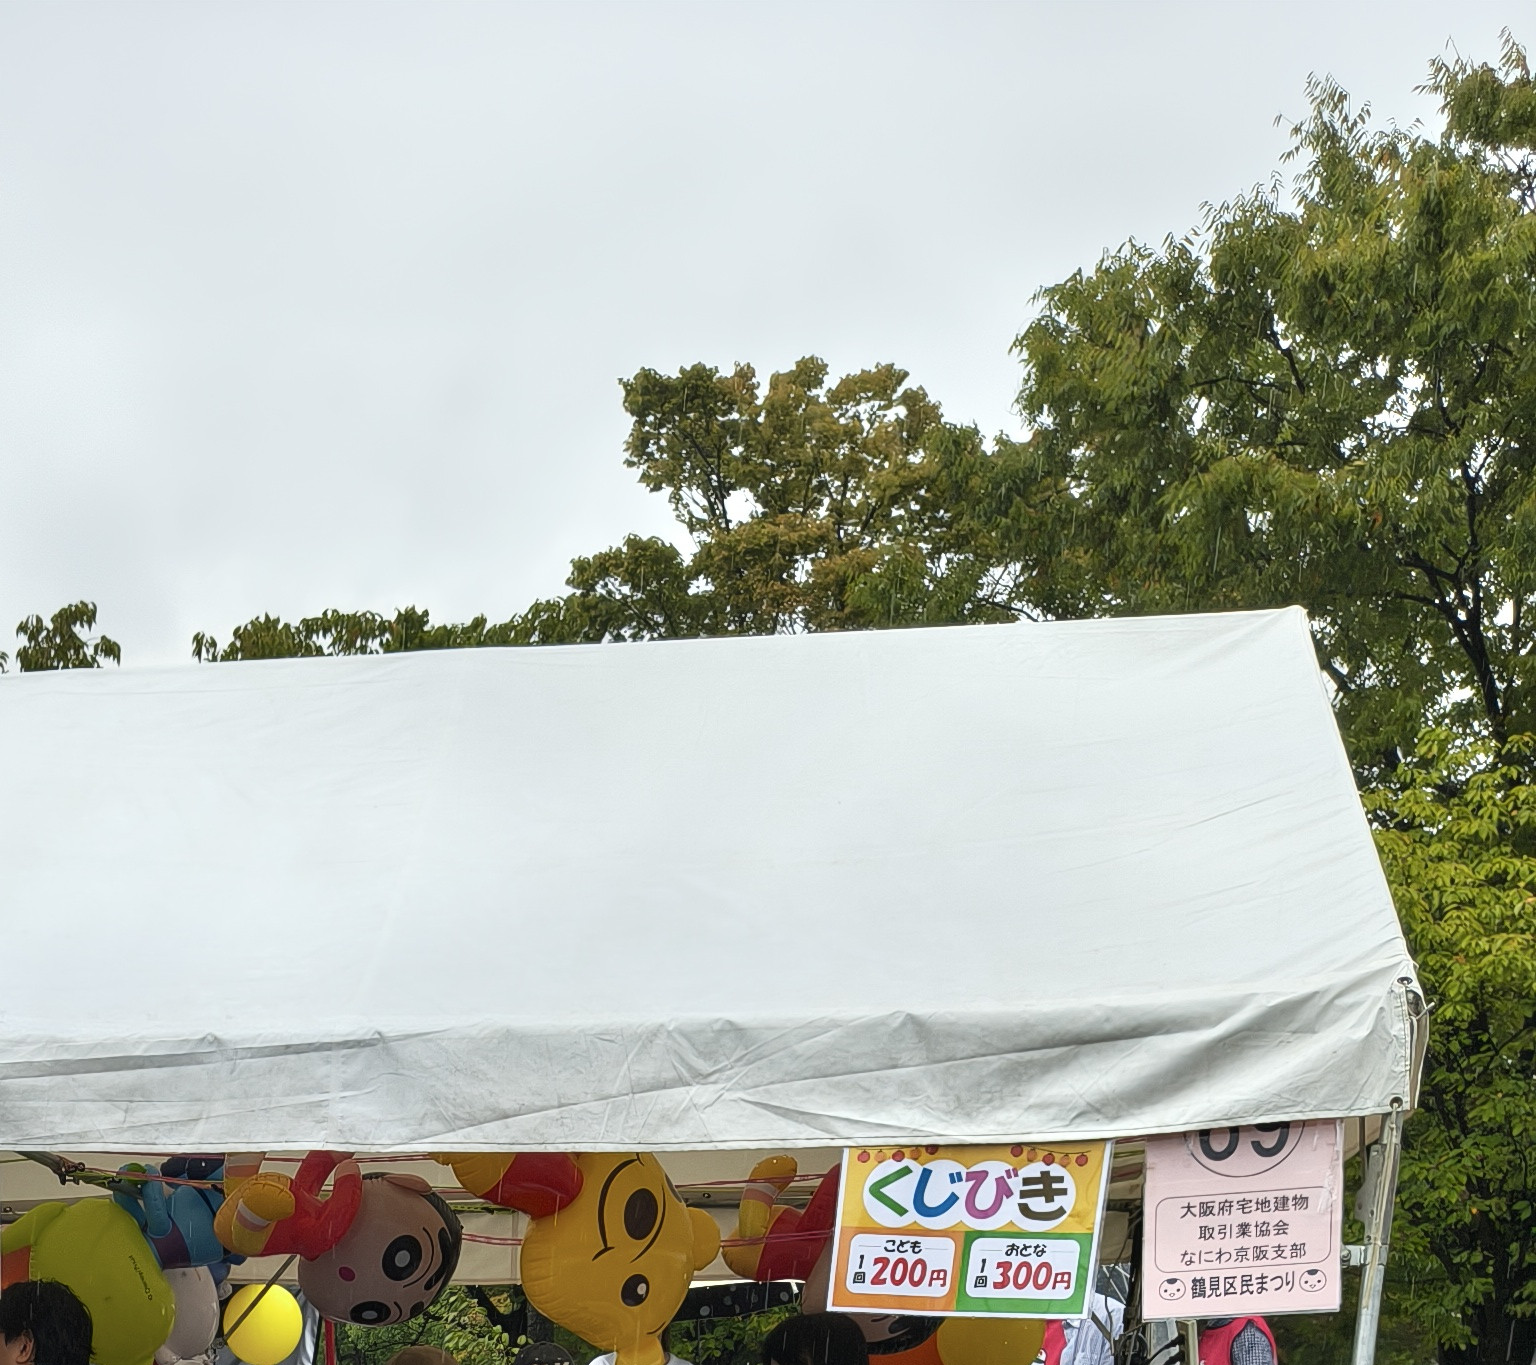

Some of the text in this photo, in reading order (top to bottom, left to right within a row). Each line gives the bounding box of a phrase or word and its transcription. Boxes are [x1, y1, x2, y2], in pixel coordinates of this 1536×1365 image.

[868, 1165, 1068, 1222] くじびき
[1180, 1194, 1310, 1219] 大阪府宅地建物
[1197, 1219, 1290, 1241] 取引業協会
[883, 1239, 922, 1254] こども
[1004, 1243, 1047, 1257] おとな
[1180, 1242, 1307, 1267] なにわ京阪支部
[852, 1254, 948, 1288] 1回 200円
[974, 1258, 1072, 1291] 1回 300円
[1191, 1270, 1296, 1300] 鶴見区民まつり
